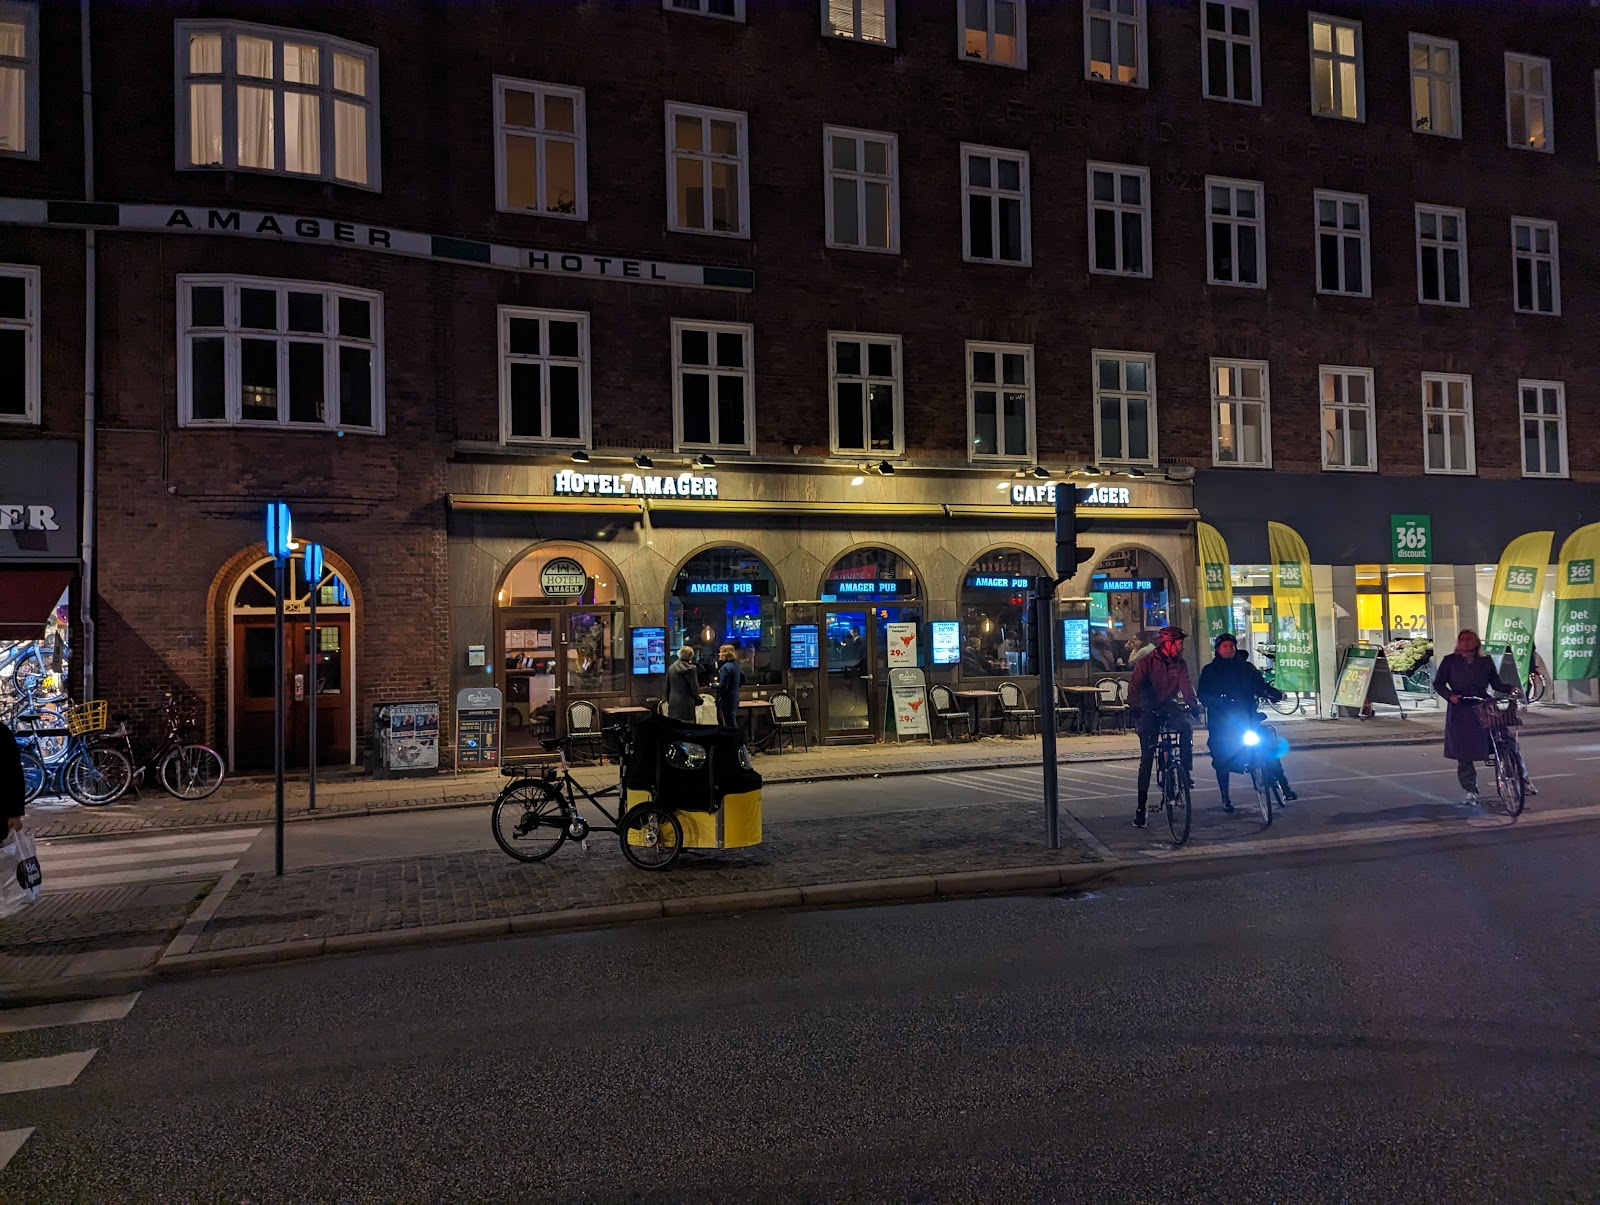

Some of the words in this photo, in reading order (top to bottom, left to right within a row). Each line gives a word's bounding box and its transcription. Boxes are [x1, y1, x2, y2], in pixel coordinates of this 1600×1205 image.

[166, 209, 391, 248] AMAGER
[528, 252, 666, 280] HOTEL
[555, 473, 626, 494] HOTEL
[630, 475, 718, 496] AMAGER
[1076, 486, 1130, 504] AGER
[1396, 527, 1427, 549] 365
[1397, 549, 1427, 558] discount
[1570, 565, 1591, 578] 365
[547, 576, 581, 584] HOTEL
[975, 577, 1009, 587] AMAGER
[1011, 579, 1028, 588] PUB
[1508, 571, 1533, 585] 365
[690, 583, 730, 593] AMAGER
[733, 583, 753, 593] PUB
[839, 583, 875, 592] AMAGER
[878, 583, 897, 592] PUB
[1103, 581, 1134, 590] AMAGER
[1136, 582, 1152, 590] PUB
[1570, 610, 1589, 620] Det
[1394, 614, 1427, 632] 8-22
[1504, 618, 1524, 629] Det
[1561, 622, 1598, 634] rigtige
[1493, 631, 1530, 643] rigtige
[1560, 635, 1584, 645] sted
[1586, 635, 1597, 645] at
[890, 649, 906, 657] 29,-
[1516, 647, 1528, 656] at
[1563, 649, 1594, 659] spare
[467, 692, 492, 702] Carlsberg
[898, 715, 916, 723] 29,-
